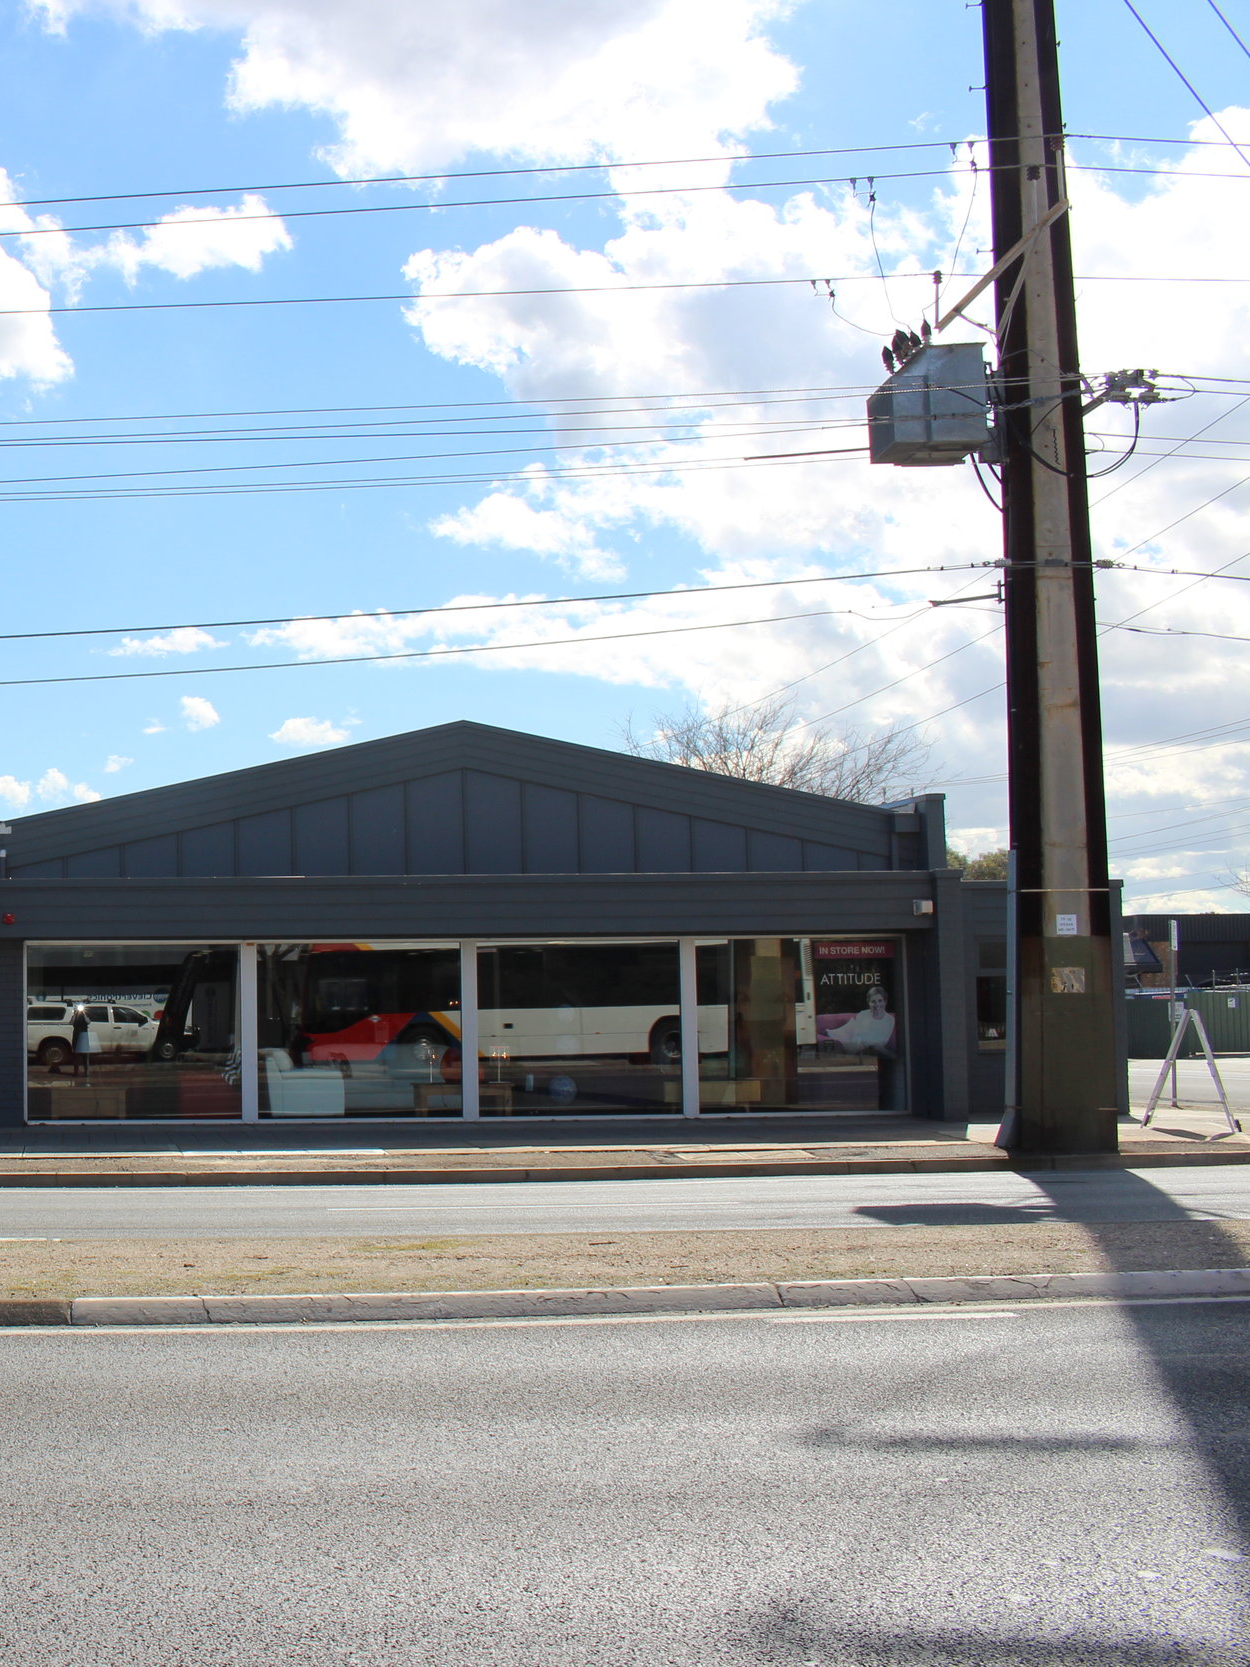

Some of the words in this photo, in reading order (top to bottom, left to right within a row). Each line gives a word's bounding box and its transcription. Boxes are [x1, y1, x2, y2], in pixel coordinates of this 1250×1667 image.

[819, 946, 828, 954] IN
[830, 946, 860, 954] STORE
[862, 945, 885, 954] NOW!
[820, 973, 881, 985] ATTITUDE
